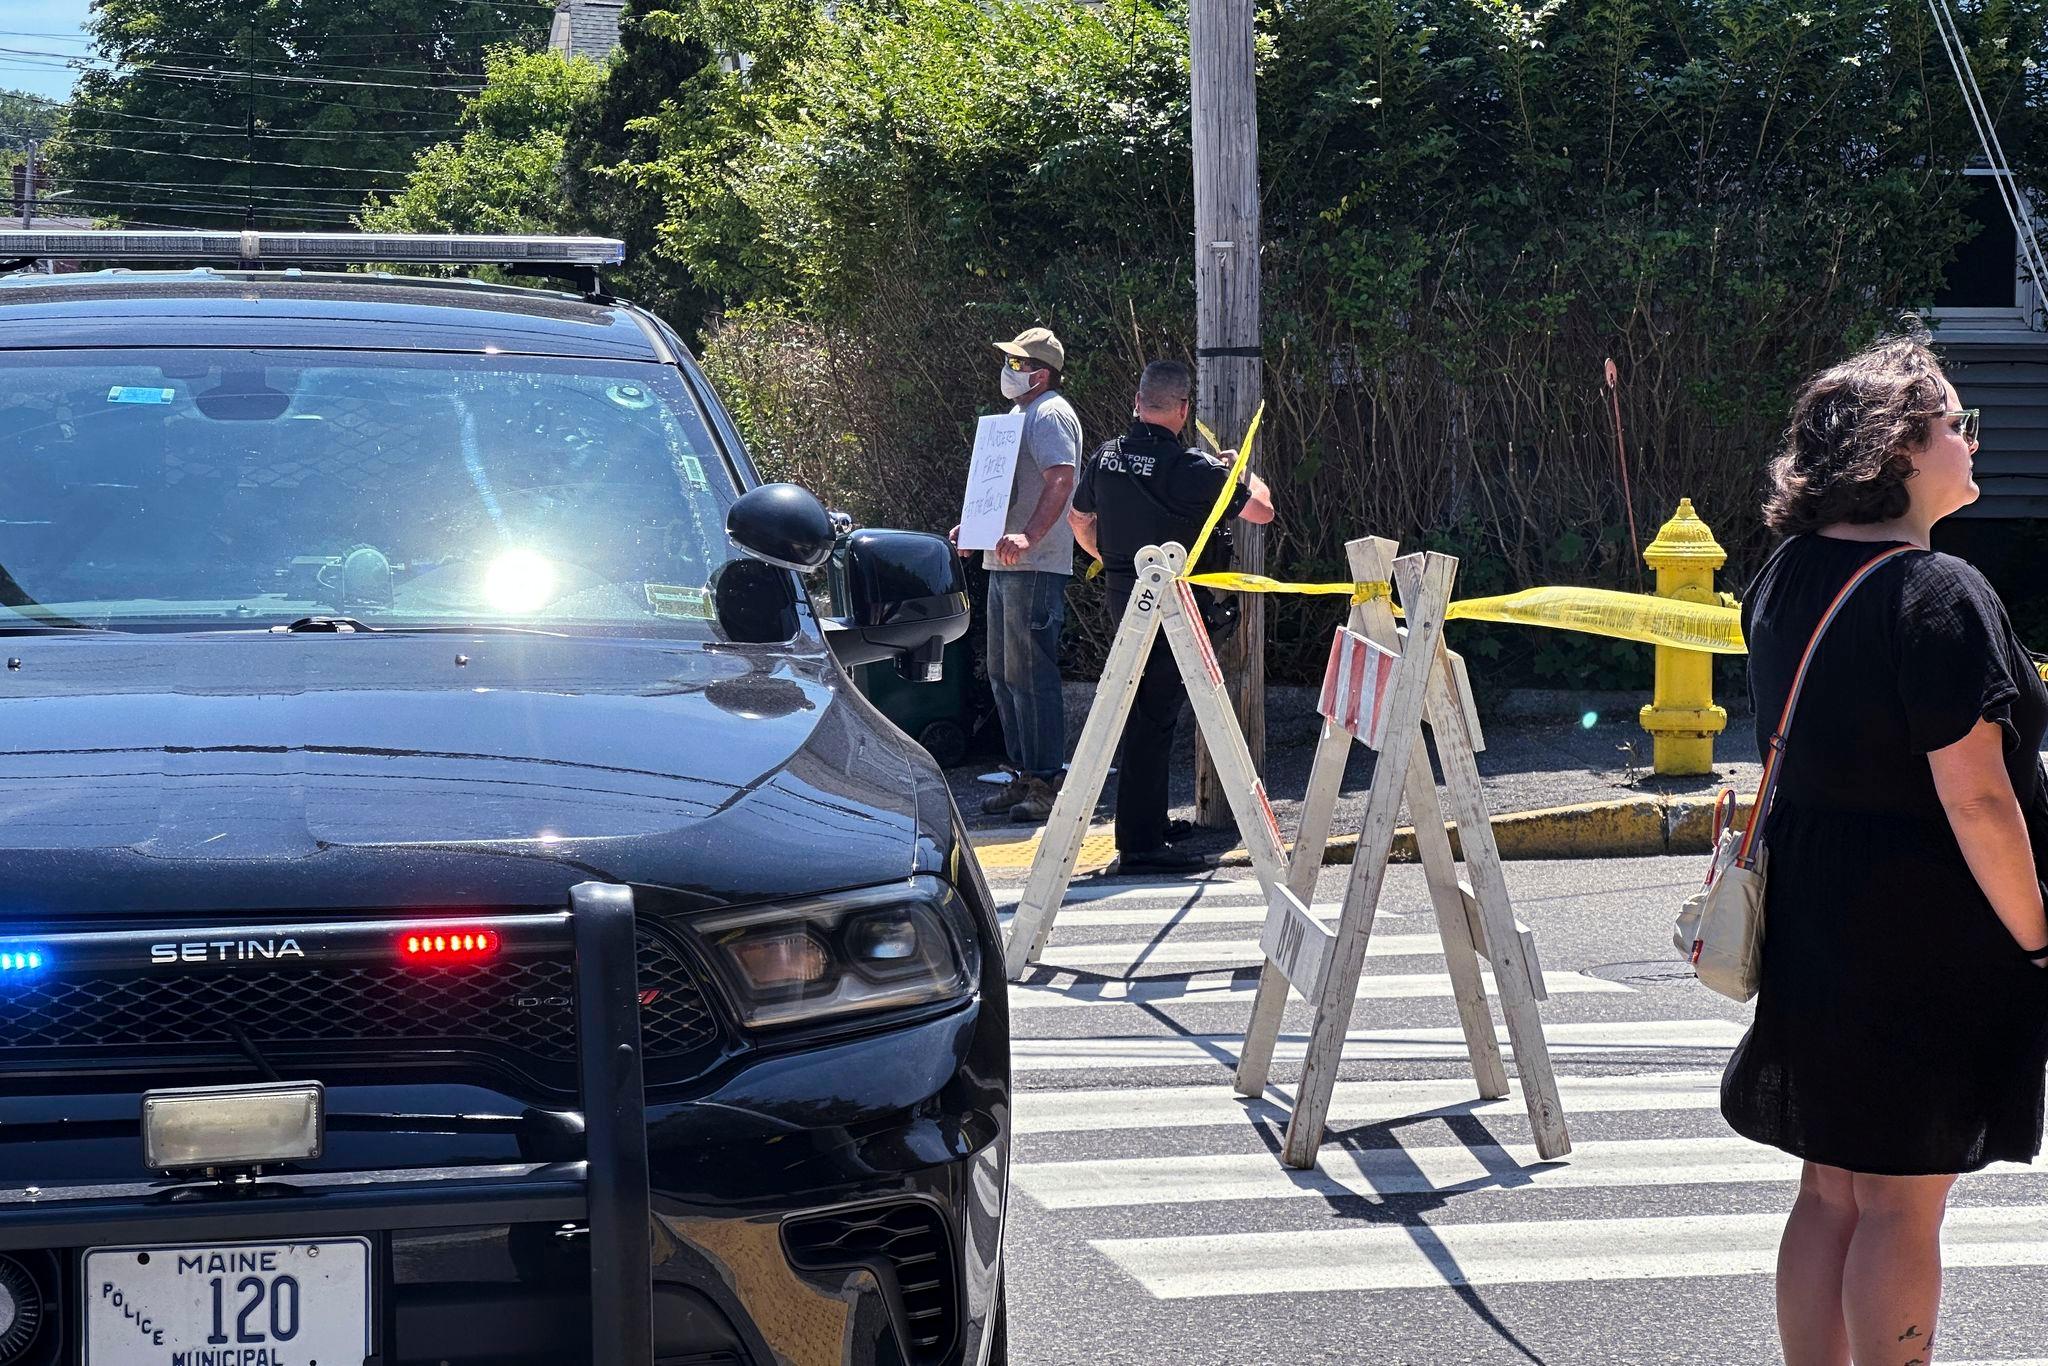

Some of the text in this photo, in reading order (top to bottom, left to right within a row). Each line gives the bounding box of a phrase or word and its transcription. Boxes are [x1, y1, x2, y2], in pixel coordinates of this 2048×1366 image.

[1099, 457, 1154, 476] POLCE
[1138, 589, 1154, 612] 40
[151, 938, 305, 964] SETINA
[178, 1252, 278, 1275] MAINE
[103, 1283, 164, 1346] POLICE
[208, 1275, 299, 1345] 120
[172, 1348, 284, 1366] MUNICIPAL
